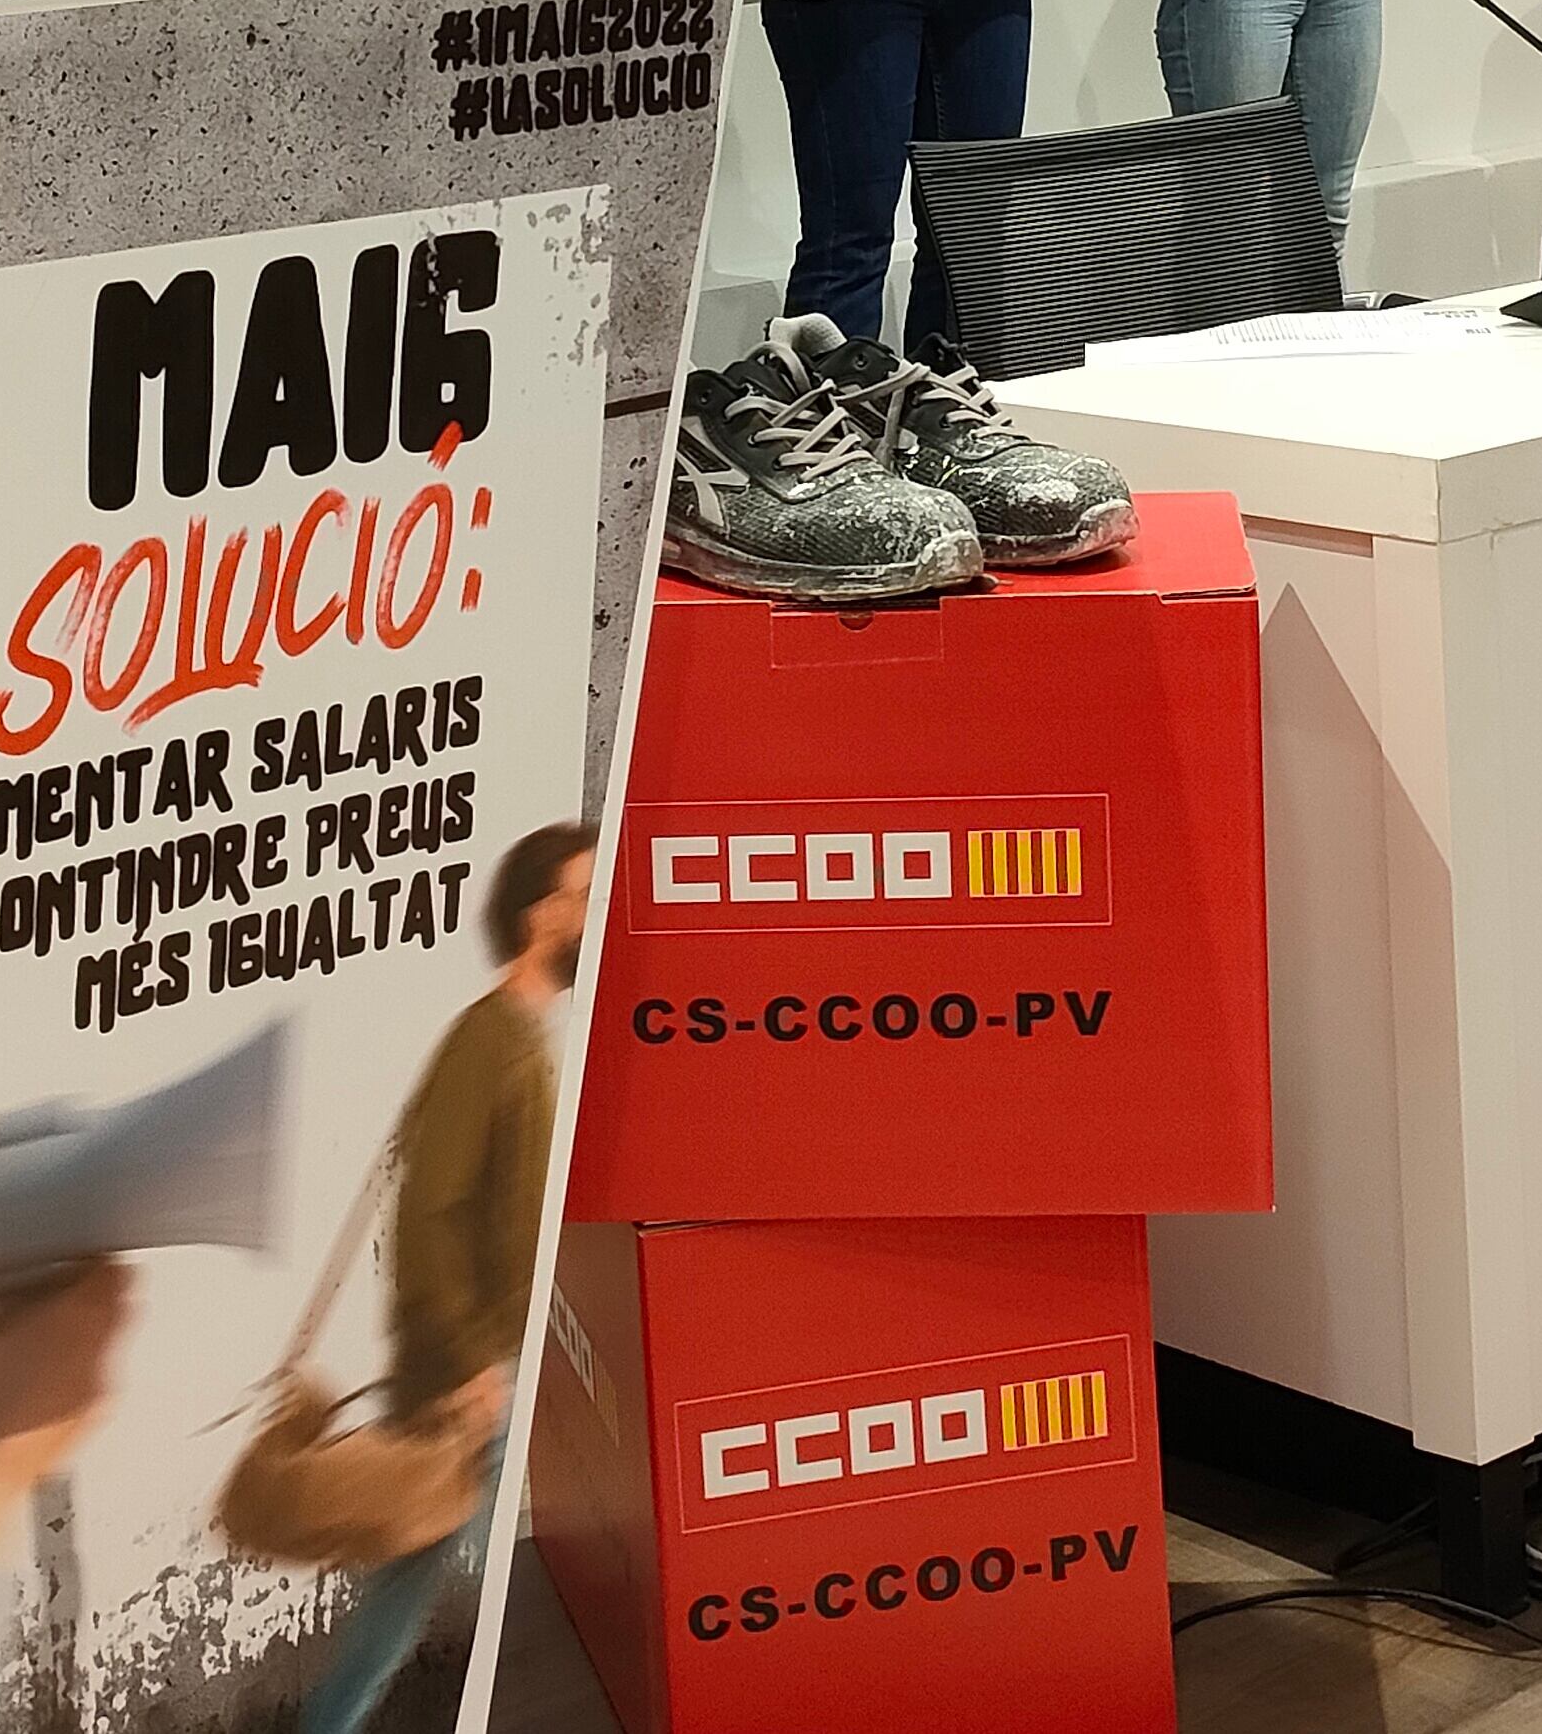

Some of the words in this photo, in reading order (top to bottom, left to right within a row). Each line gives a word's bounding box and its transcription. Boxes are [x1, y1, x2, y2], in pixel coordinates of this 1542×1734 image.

[448, 50, 712, 142] #LASOLUCIÓ
[88, 228, 501, 512] MAIG
[250, 675, 483, 794] SALARIS
[305, 771, 476, 877] PREUS
[652, 830, 951, 904] CCOO
[74, 921, 192, 1034] MÉS
[208, 863, 472, 995] IGUALTAT
[632, 989, 1114, 1046] CS-CCOO-PV
[701, 1388, 988, 1500] CCOO
[687, 1526, 1140, 1643] CS-CCOO-PV
